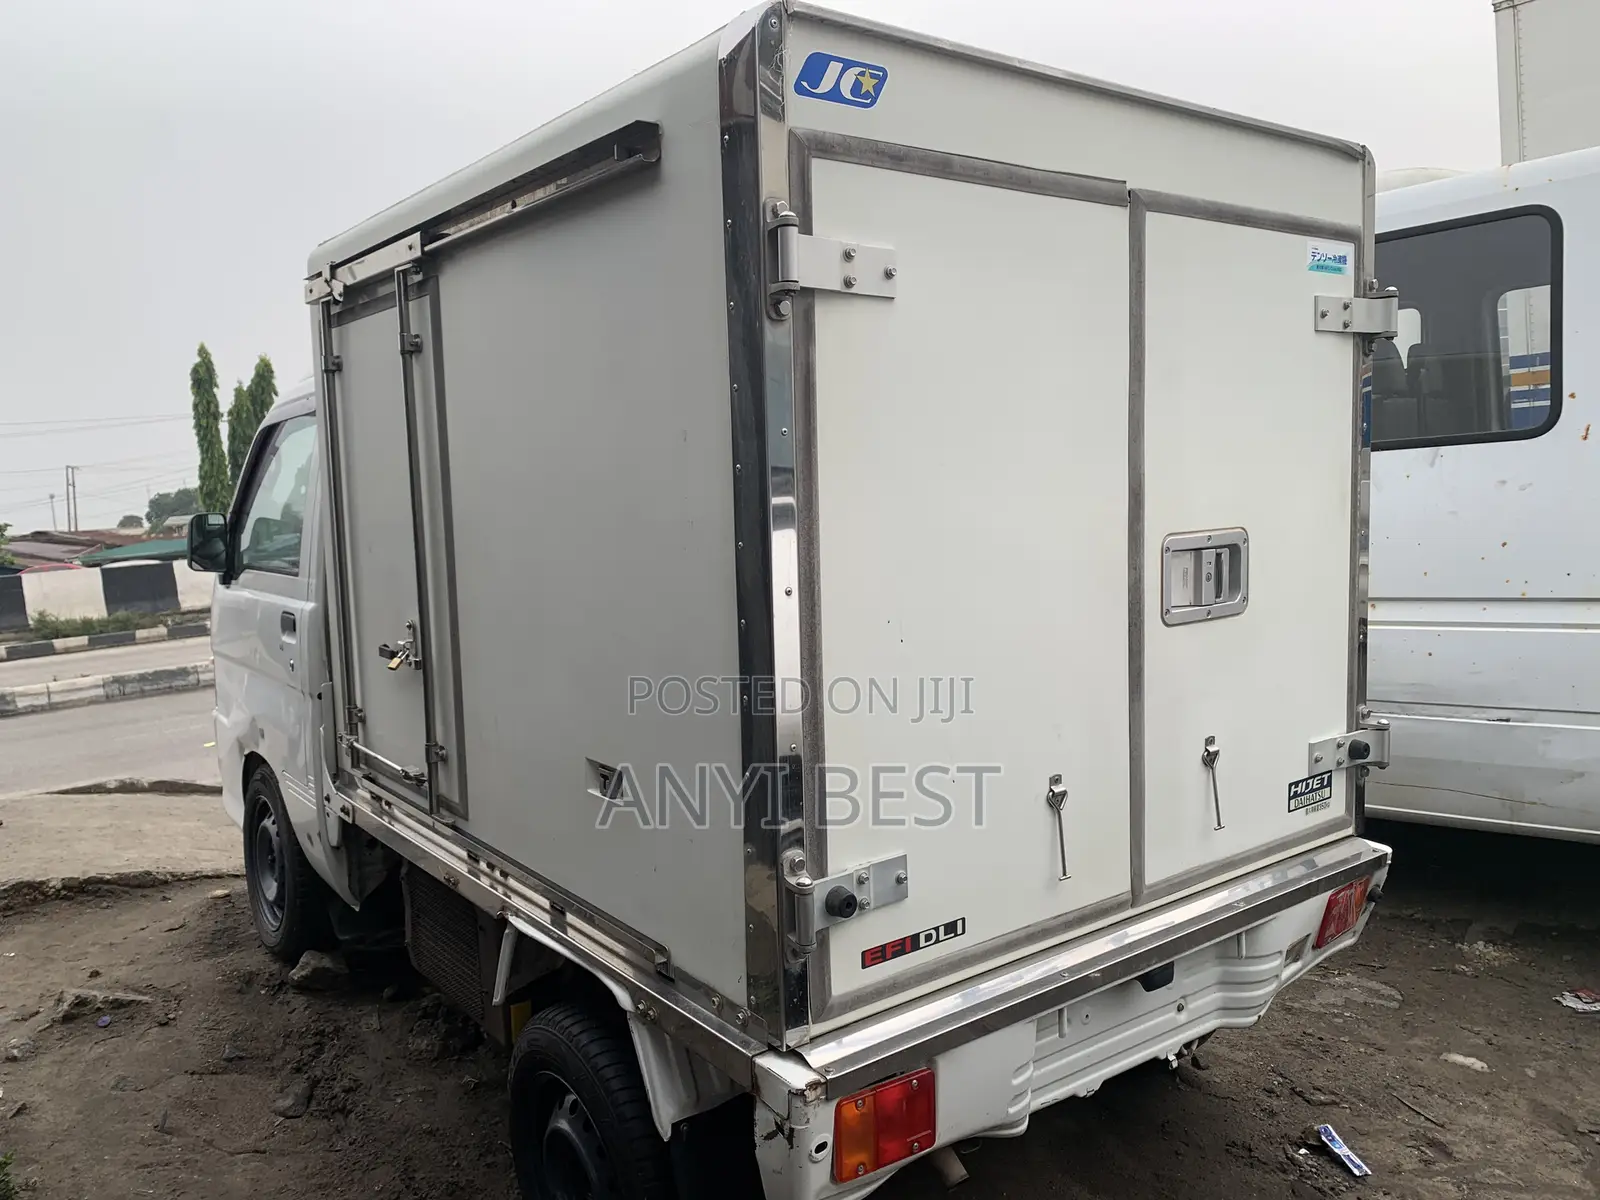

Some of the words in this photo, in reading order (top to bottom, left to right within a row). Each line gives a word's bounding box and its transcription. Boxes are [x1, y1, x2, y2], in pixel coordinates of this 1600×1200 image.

[800, 60, 884, 104] JC
[1289, 772, 1332, 798] HIJET
[1294, 788, 1326, 809] DAIHATSU
[864, 936, 912, 967] EFI
[919, 919, 963, 949] DLI
